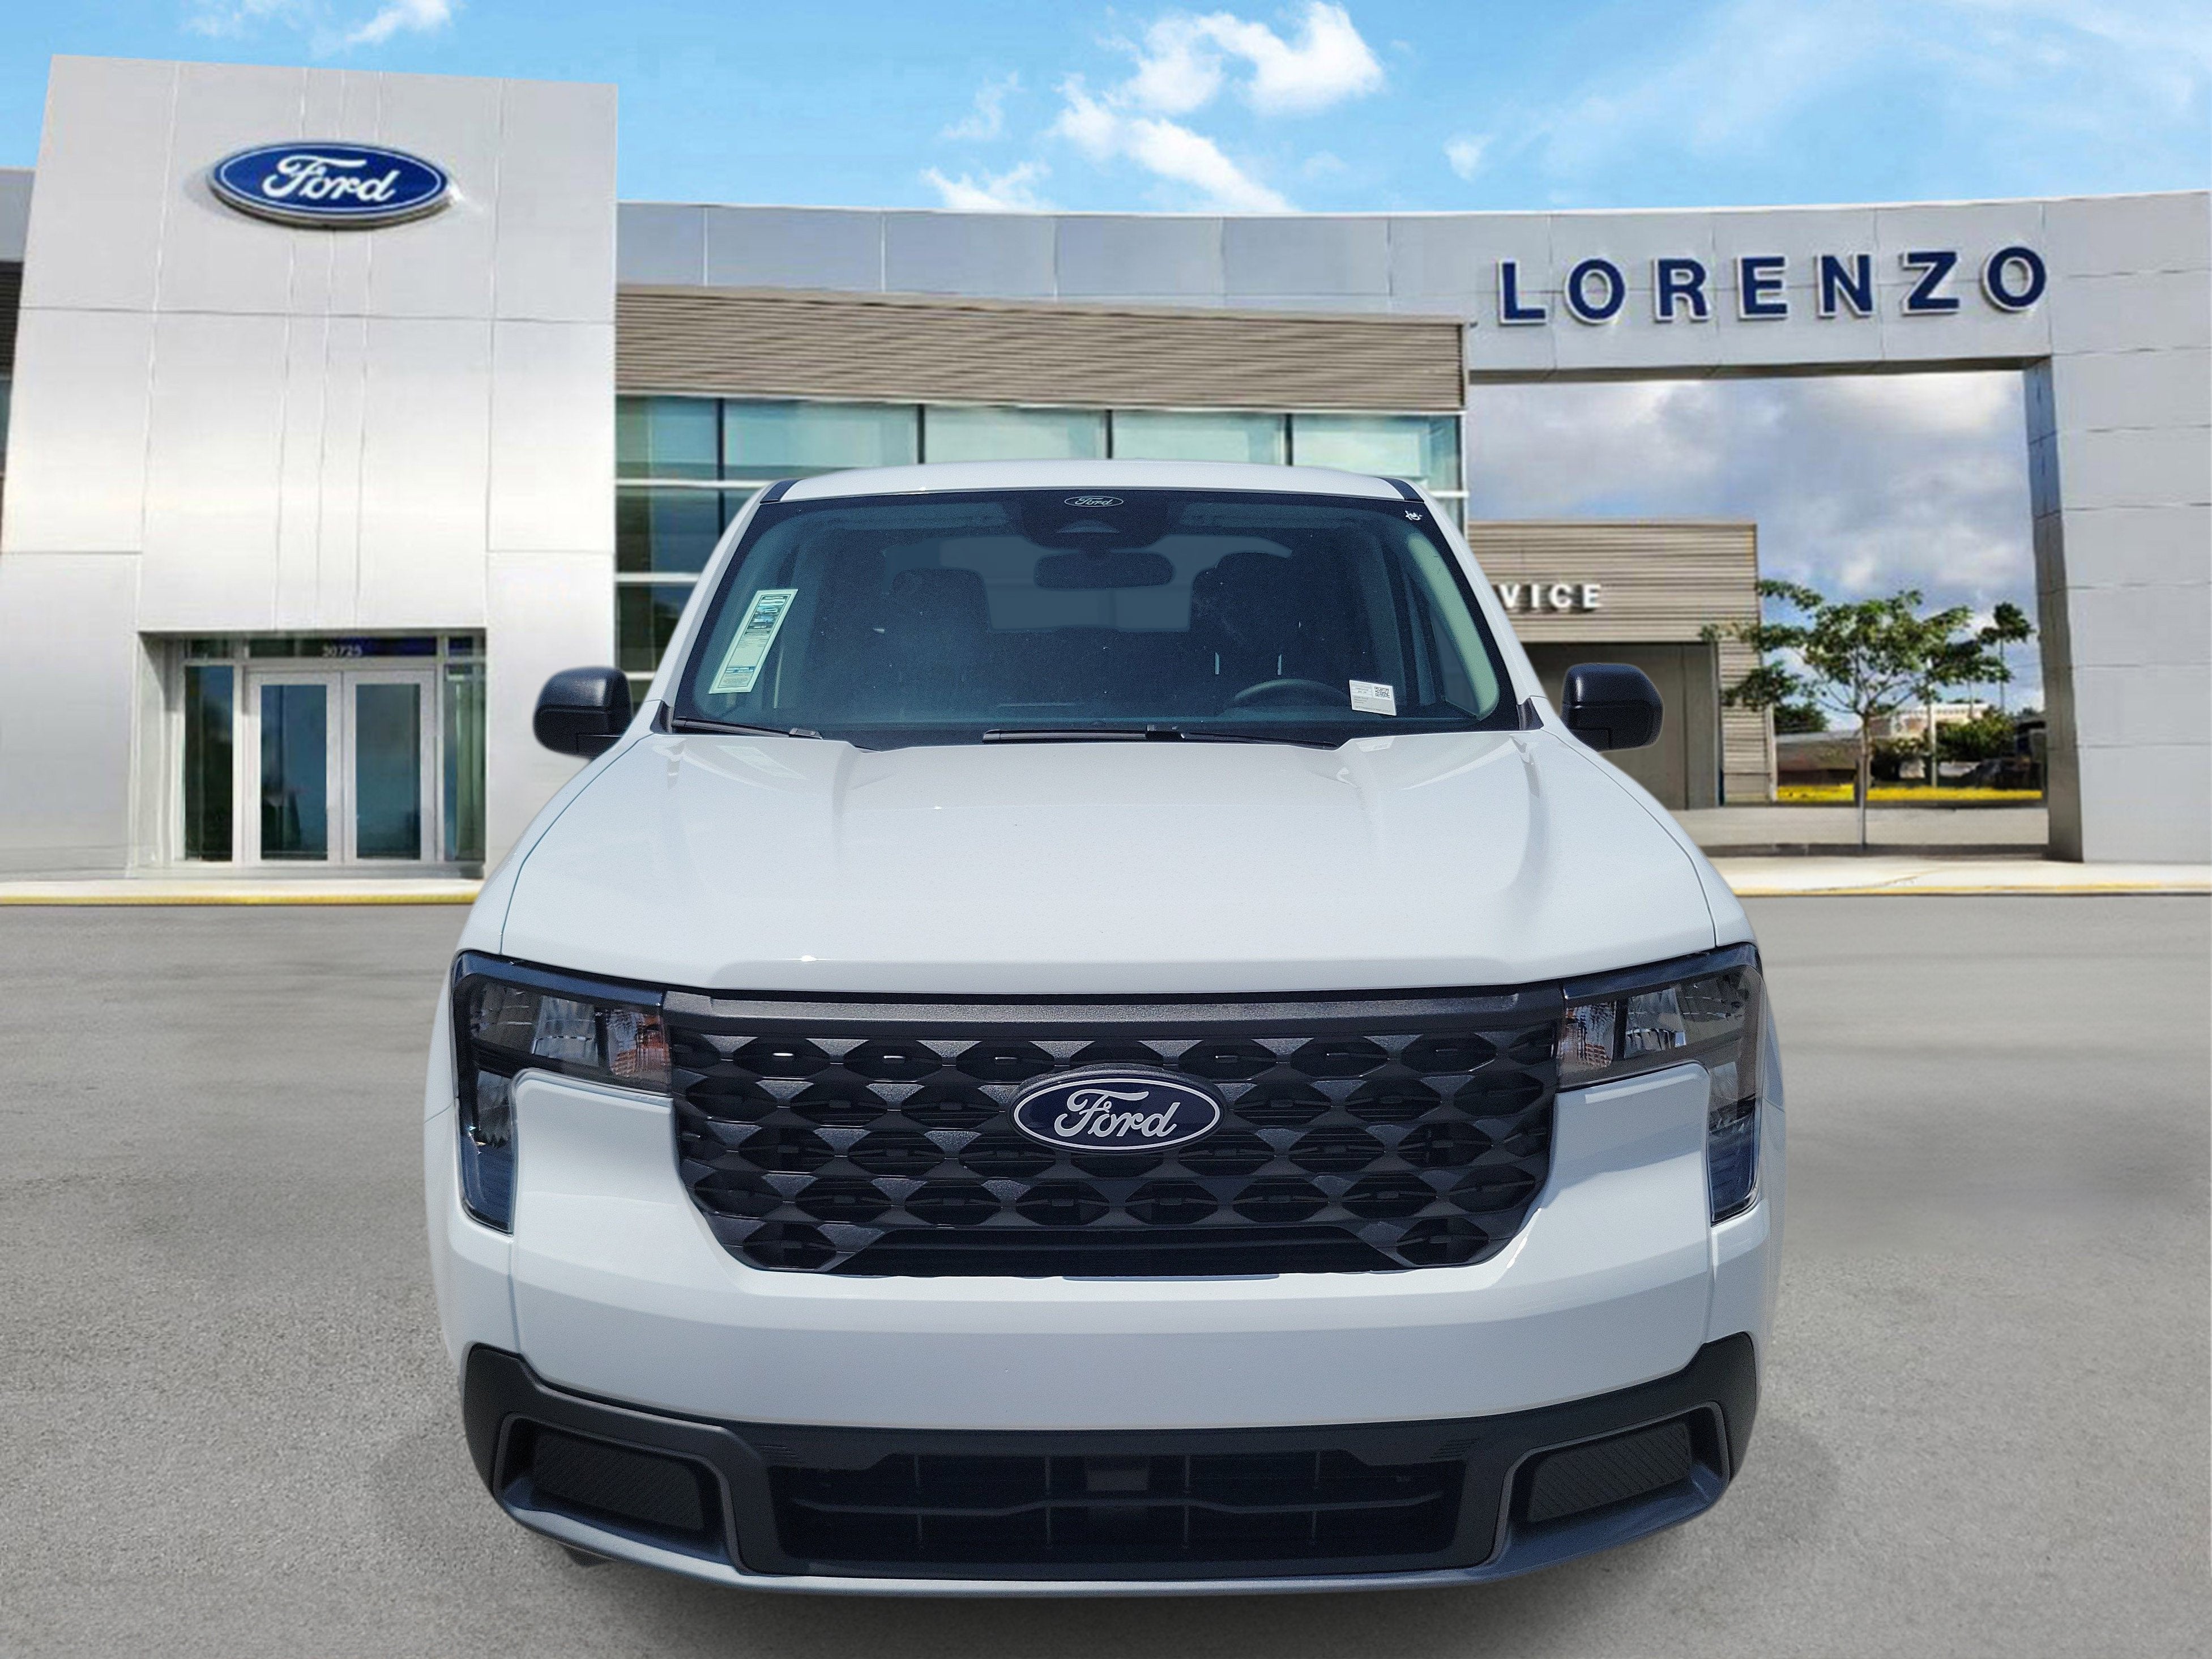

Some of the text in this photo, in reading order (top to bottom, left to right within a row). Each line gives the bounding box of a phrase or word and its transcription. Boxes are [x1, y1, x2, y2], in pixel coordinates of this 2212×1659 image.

[262, 155, 400, 202] Ford
[1498, 246, 2047, 325] LORENZO
[1054, 1089, 1181, 1137] Ford
